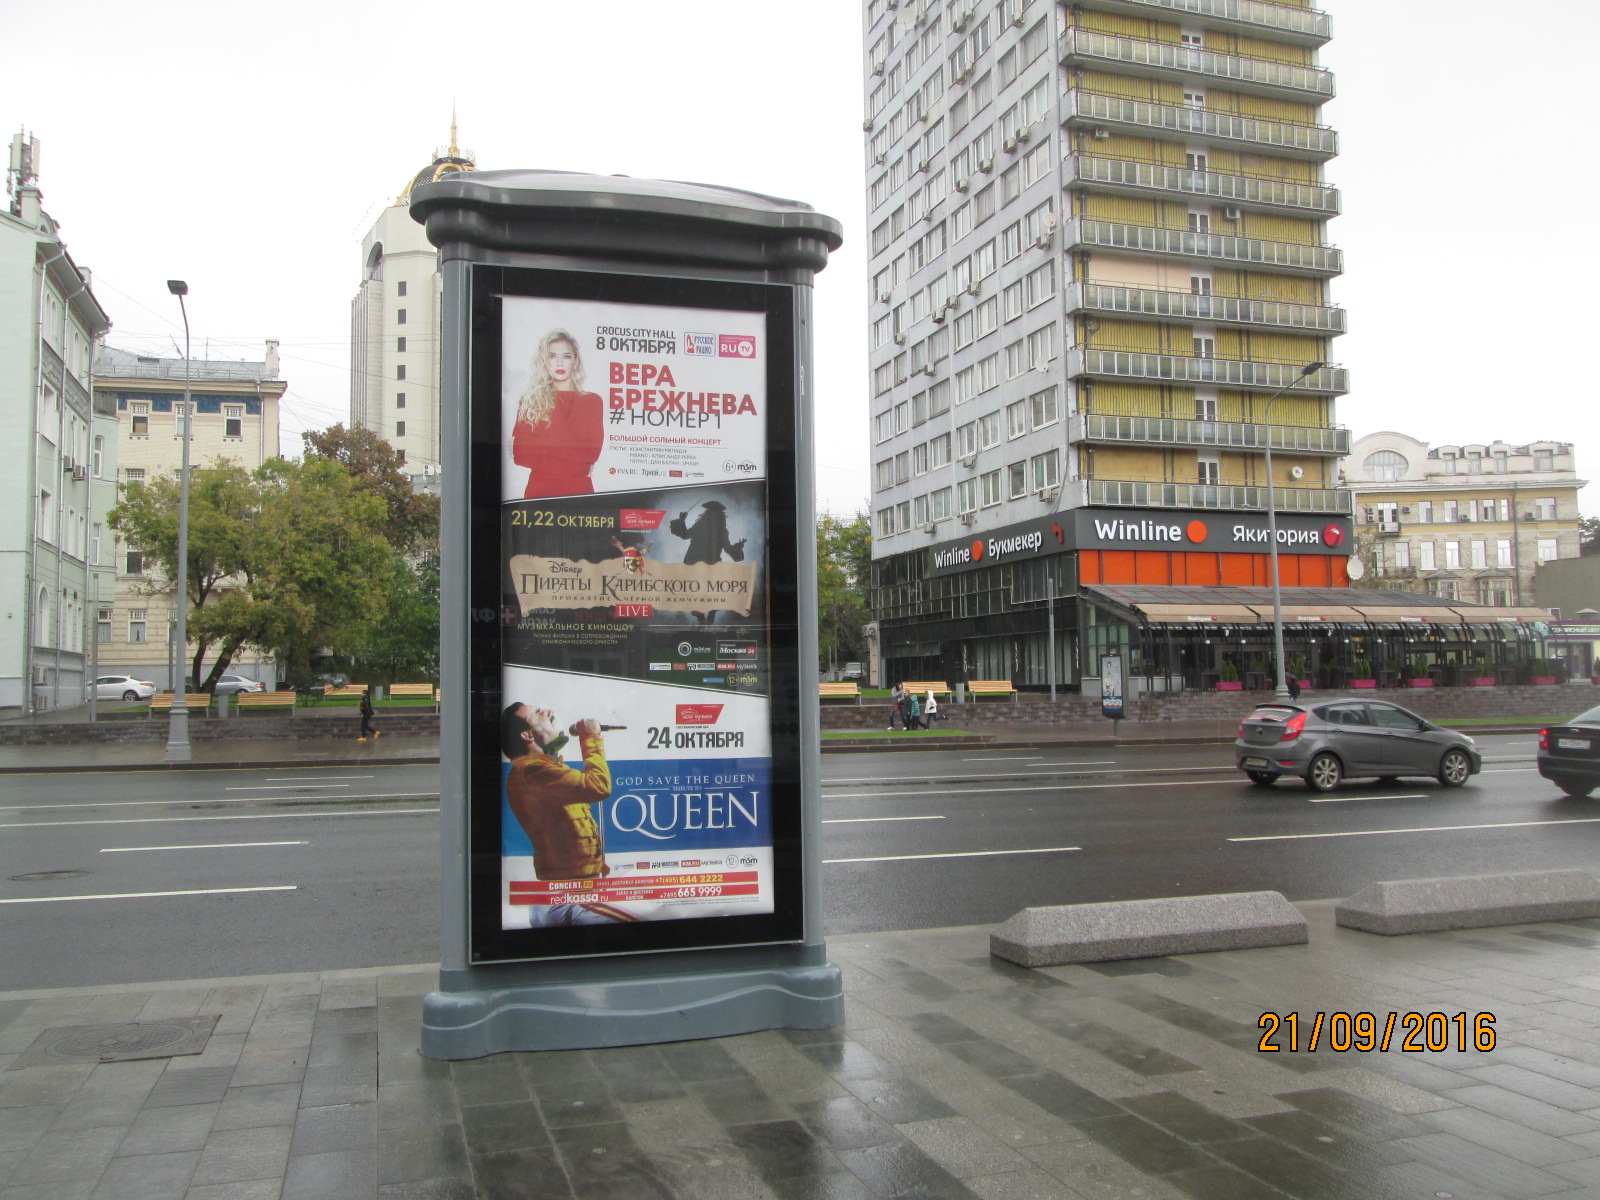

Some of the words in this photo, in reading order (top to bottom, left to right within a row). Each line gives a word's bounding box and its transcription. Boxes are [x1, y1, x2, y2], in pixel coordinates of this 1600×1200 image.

[596, 325, 631, 336] CROCUS
[632, 328, 652, 338] CITY
[652, 329, 677, 340] HALL
[596, 336, 606, 351] 8
[609, 336, 676, 355] ОКТЯБРЯ
[720, 343, 737, 354] RU
[740, 345, 751, 353] TV
[609, 361, 676, 387] ВЕРА
[609, 387, 758, 416] БРЕЖНЕВА
[609, 434, 648, 443] БОЛЬШОЙ
[650, 436, 686, 445] СОЛЬНЫЙ
[687, 438, 722, 446] КОНЦЕРТ
[557, 515, 614, 529] ОКТЯБРЯ
[1094, 519, 1182, 542] Winline
[988, 531, 1042, 560] Букмекер
[934, 547, 970, 569] Winline
[618, 605, 649, 617] LIVE
[517, 623, 585, 631] МУЗЫКАЛЬНОЕ
[719, 646, 746, 654] Москва
[647, 726, 672, 749] 24
[674, 732, 744, 748] ОКТЯБРЯ
[616, 776, 642, 786] GOD
[648, 776, 680, 785] SAVE
[686, 775, 709, 784] THE
[714, 774, 755, 784] QUEEN
[611, 791, 760, 840] QUEEN
[680, 875, 697, 884] 644
[700, 874, 724, 882] 2222
[678, 887, 696, 898] 665
[698, 886, 722, 897] 9999
